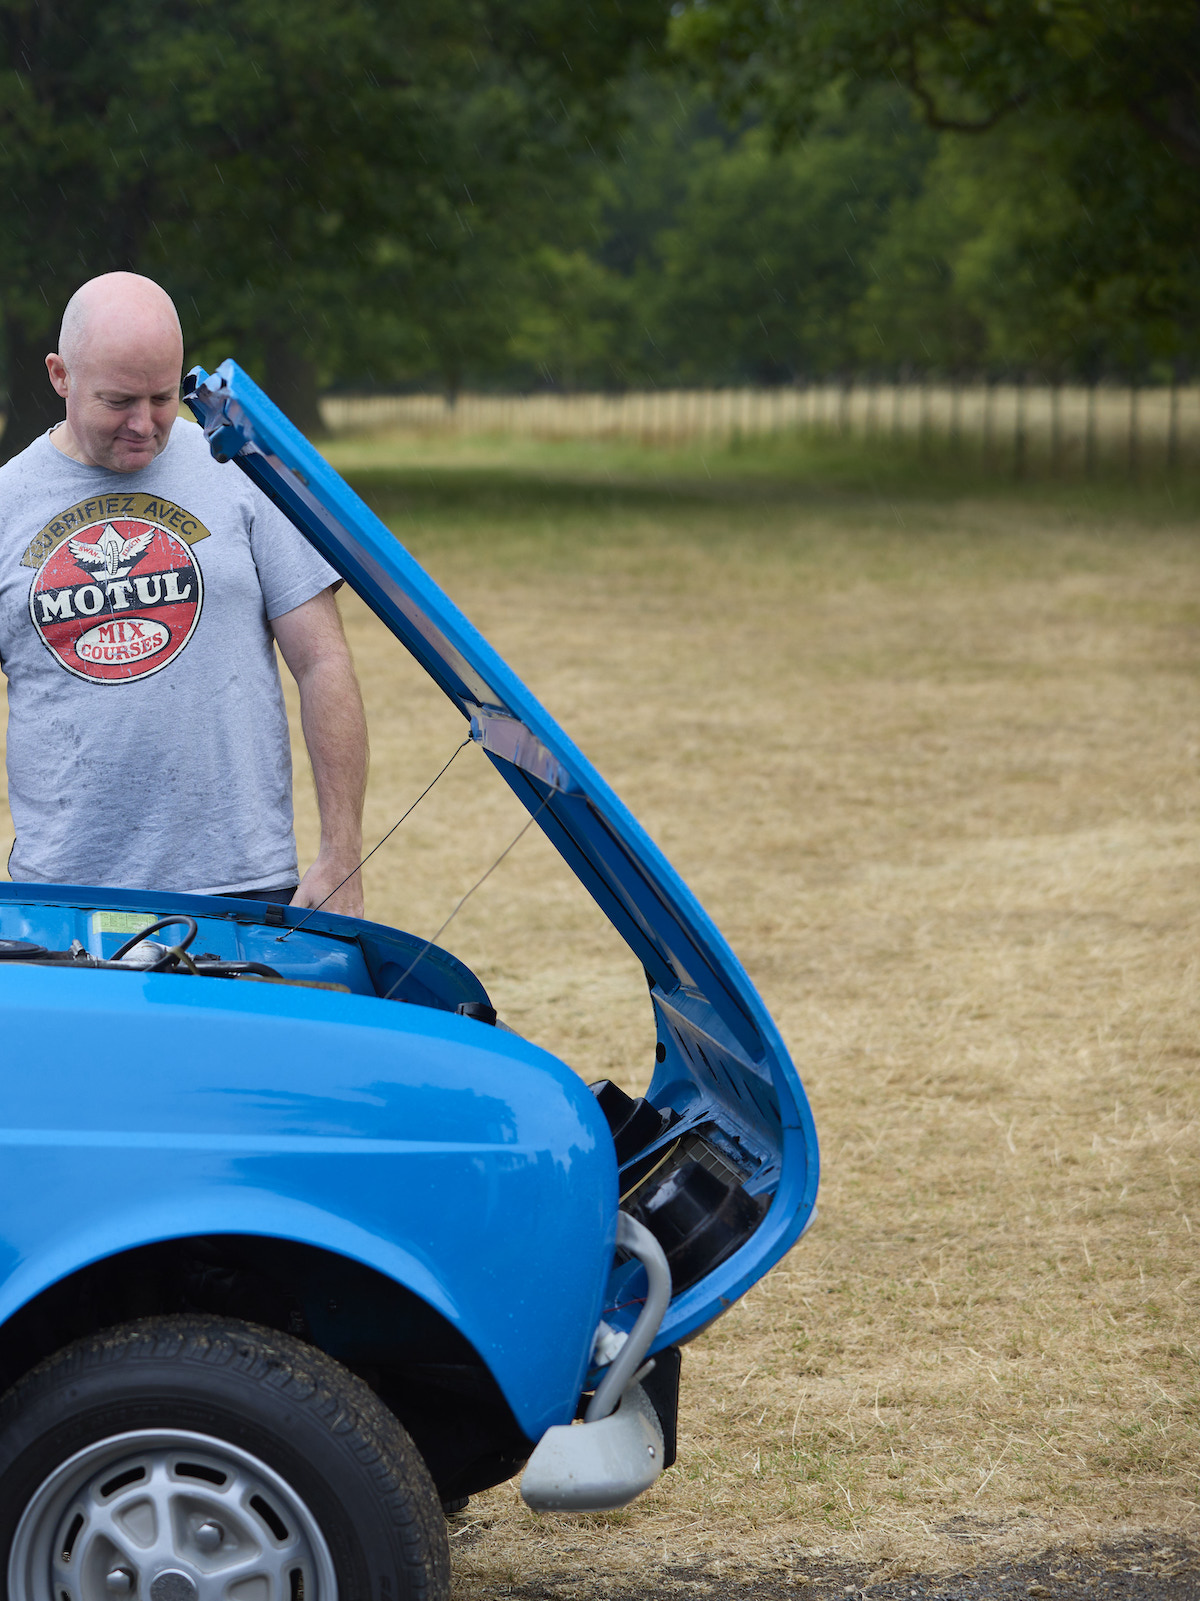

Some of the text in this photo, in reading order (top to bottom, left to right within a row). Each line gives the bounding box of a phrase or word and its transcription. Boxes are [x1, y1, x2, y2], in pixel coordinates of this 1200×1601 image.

[31, 497, 197, 559] LUBRIFIEZ AVEC
[37, 572, 192, 622] MOTUL
[81, 632, 163, 660] COURSES
[98, 622, 145, 643] MIX
